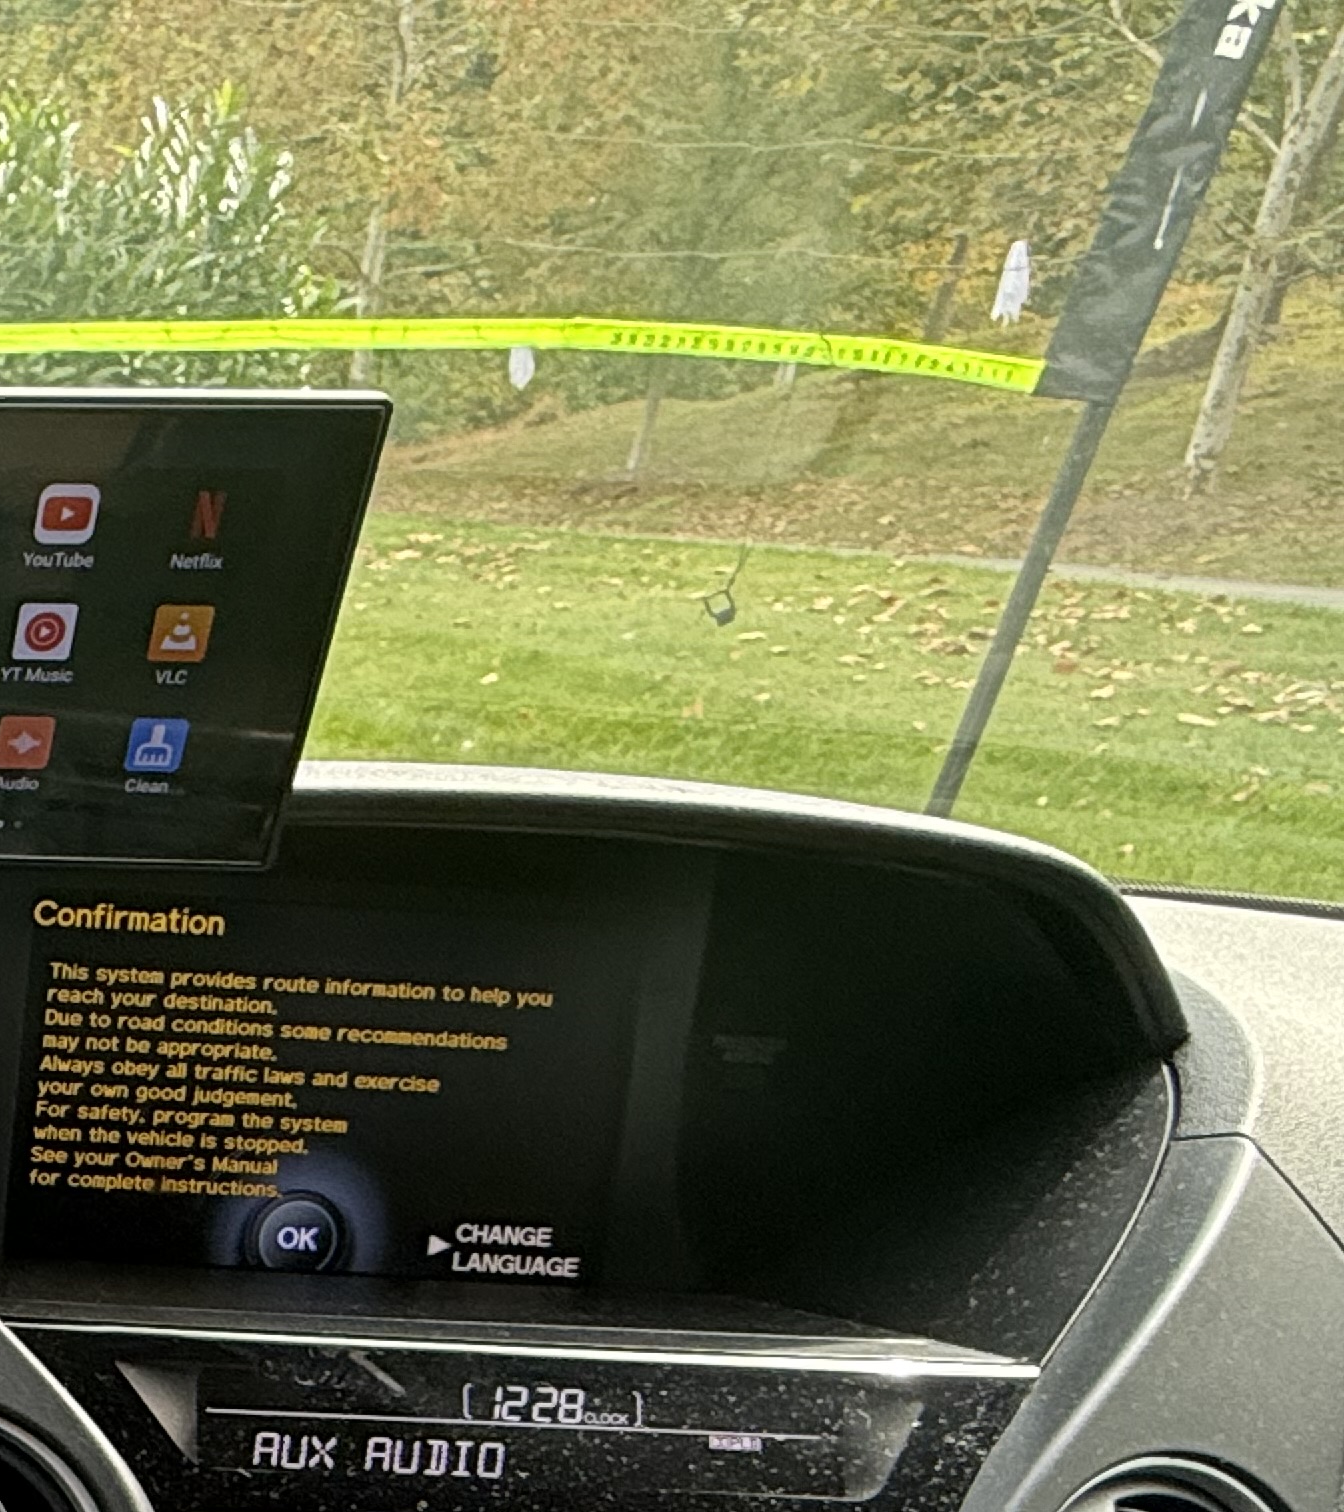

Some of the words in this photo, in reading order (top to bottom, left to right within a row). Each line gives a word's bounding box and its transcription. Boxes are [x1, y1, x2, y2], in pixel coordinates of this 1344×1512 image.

[22, 551, 94, 569] YouTube
[170, 552, 223, 571] Netflix
[0, 667, 22, 683] YT
[25, 667, 74, 684] Music
[154, 670, 188, 685] VLC
[33, 900, 226, 937] Confirmation
[49, 962, 89, 981] This
[95, 966, 164, 987] system
[170, 970, 257, 990] provides
[263, 976, 319, 994] route
[325, 977, 436, 1001] information
[442, 985, 465, 1002] to
[470, 986, 511, 1008] help
[517, 991, 554, 1009] you
[46, 986, 104, 1005] reach
[110, 991, 157, 1009] your
[162, 993, 278, 1016] destination.
[44, 1009, 83, 1027] Due
[89, 1011, 111, 1029] to
[116, 1014, 165, 1032] road
[171, 1017, 274, 1038] conditions
[280, 1023, 331, 1042] some
[336, 1026, 508, 1051] recommendations
[42, 1034, 79, 1054] may
[85, 1035, 119, 1052] not
[125, 1036, 151, 1054] be
[157, 1041, 278, 1062] appropriate.
[39, 1055, 105, 1077] Always
[111, 1058, 160, 1081] obey
[165, 1062, 187, 1079] all
[194, 1063, 259, 1083] traffic
[263, 1066, 305, 1086] laws
[312, 1071, 348, 1088] and
[354, 1074, 441, 1093] exercise
[38, 1079, 81, 1098] your
[90, 1083, 130, 1099] own
[136, 1084, 187, 1103] good
[35, 1100, 69, 1118] For
[153, 1109, 234, 1130] program
[242, 1112, 273, 1129] the
[280, 1115, 348, 1135] system
[33, 1125, 81, 1143] when
[89, 1127, 121, 1145] the
[126, 1129, 194, 1149] vehicle
[200, 1133, 217, 1150] is
[224, 1135, 309, 1155] stopped.
[30, 1146, 68, 1164] See
[74, 1150, 119, 1168] your
[125, 1151, 205, 1171] Owner's
[212, 1157, 278, 1176] Manual
[29, 1168, 61, 1186] for
[67, 1171, 154, 1193] complete
[161, 1174, 283, 1199] instructions.
[277, 1226, 320, 1251] OK
[455, 1223, 553, 1249] CHANGE
[451, 1251, 580, 1278] LANGUAGE
[252, 1431, 337, 1470] AUX
[364, 1437, 506, 1479] AUDIO
